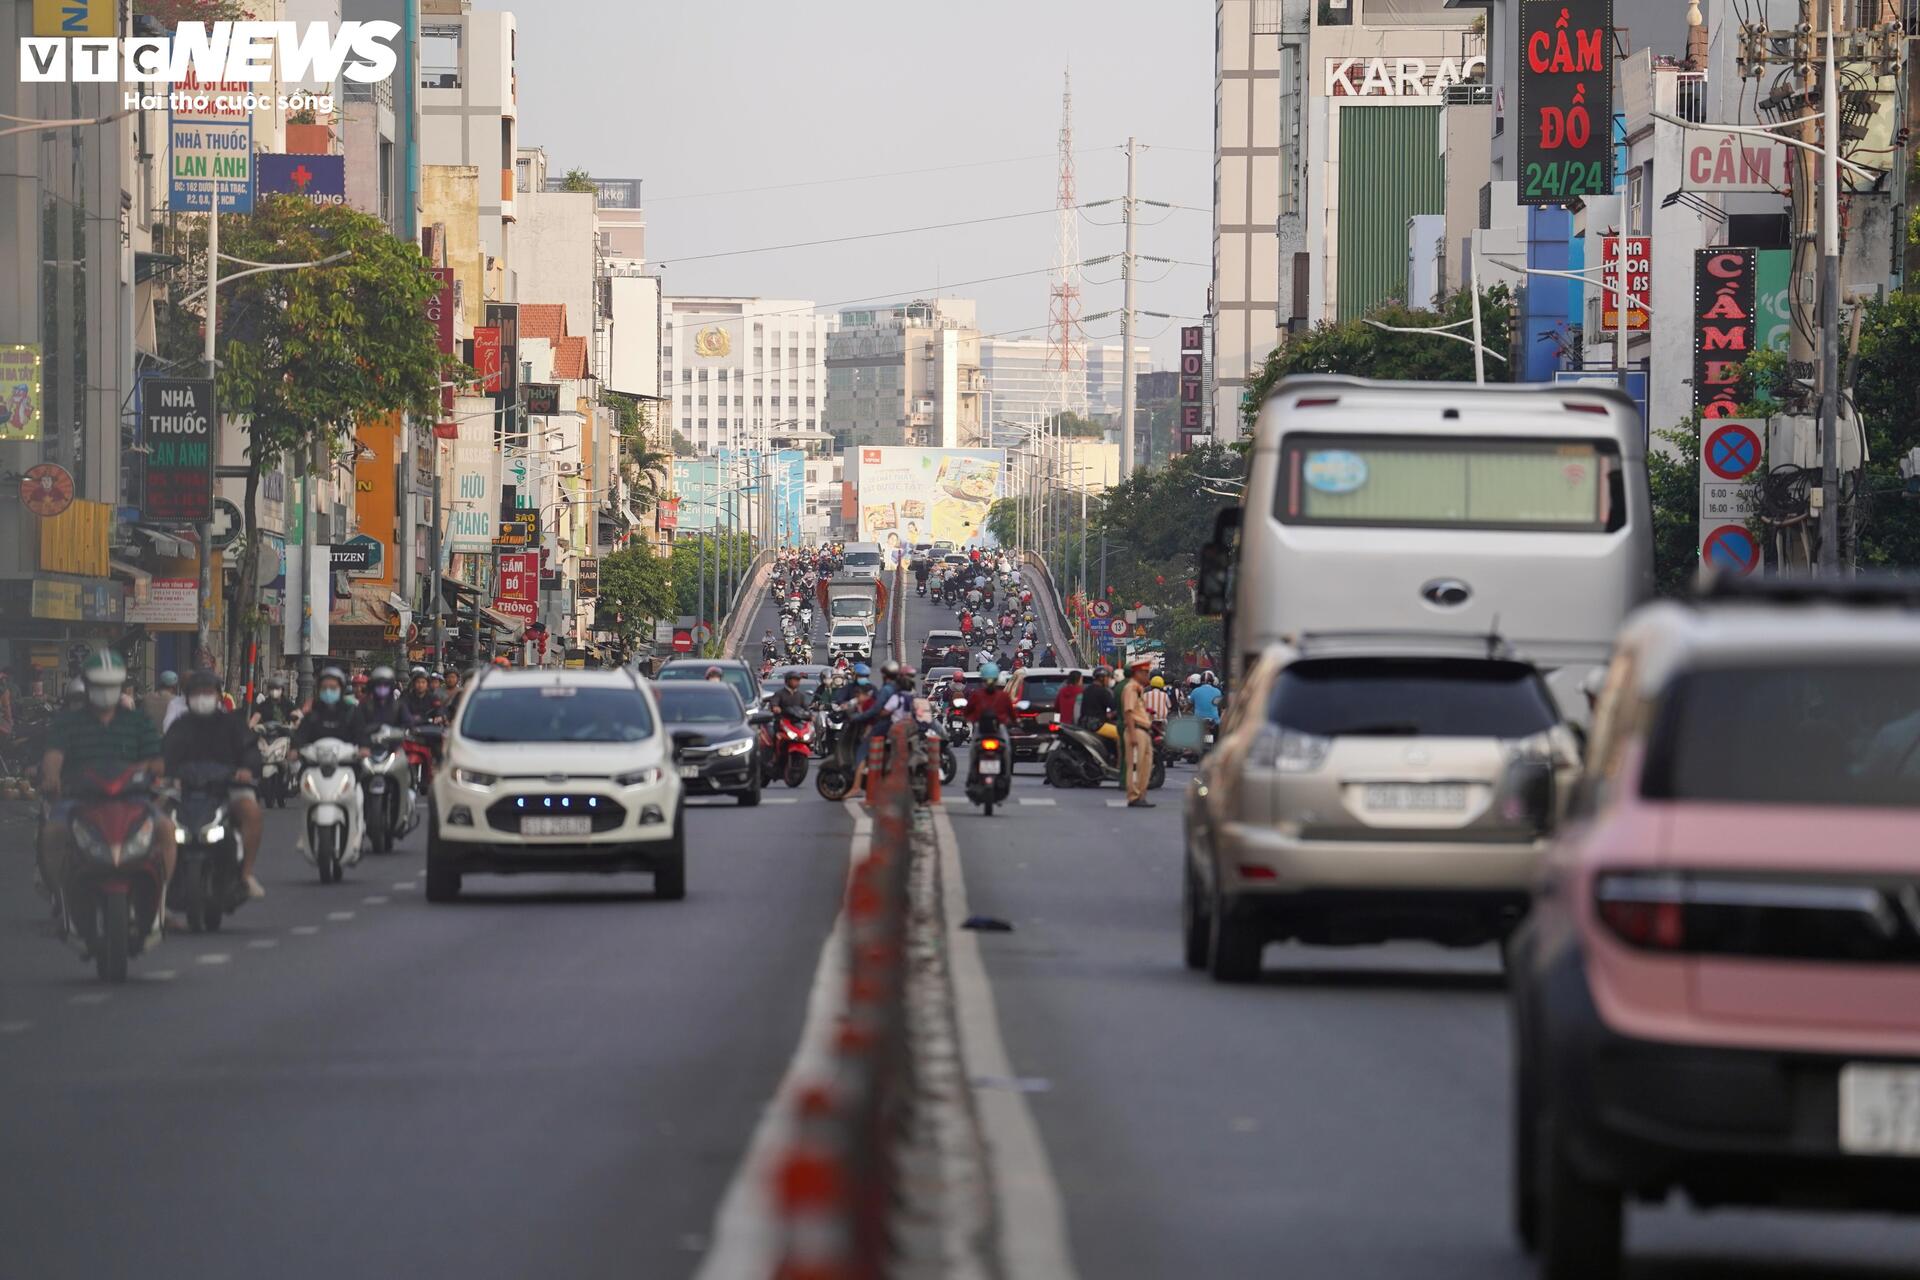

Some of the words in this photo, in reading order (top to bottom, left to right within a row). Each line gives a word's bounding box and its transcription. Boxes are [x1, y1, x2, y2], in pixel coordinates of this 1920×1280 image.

[1528, 8, 1603, 73] CẦM
[1540, 82, 1590, 149] ĐỒ
[206, 128, 247, 150] THUỐC
[175, 155, 207, 177] LAN
[1690, 134, 1771, 184] CẦM
[1526, 160, 1603, 197] 24/24
[1633, 275, 1649, 292] BS
[1612, 293, 1641, 309] LN
[161, 385, 196, 408] NHÀ
[150, 410, 207, 434] THUỐC
